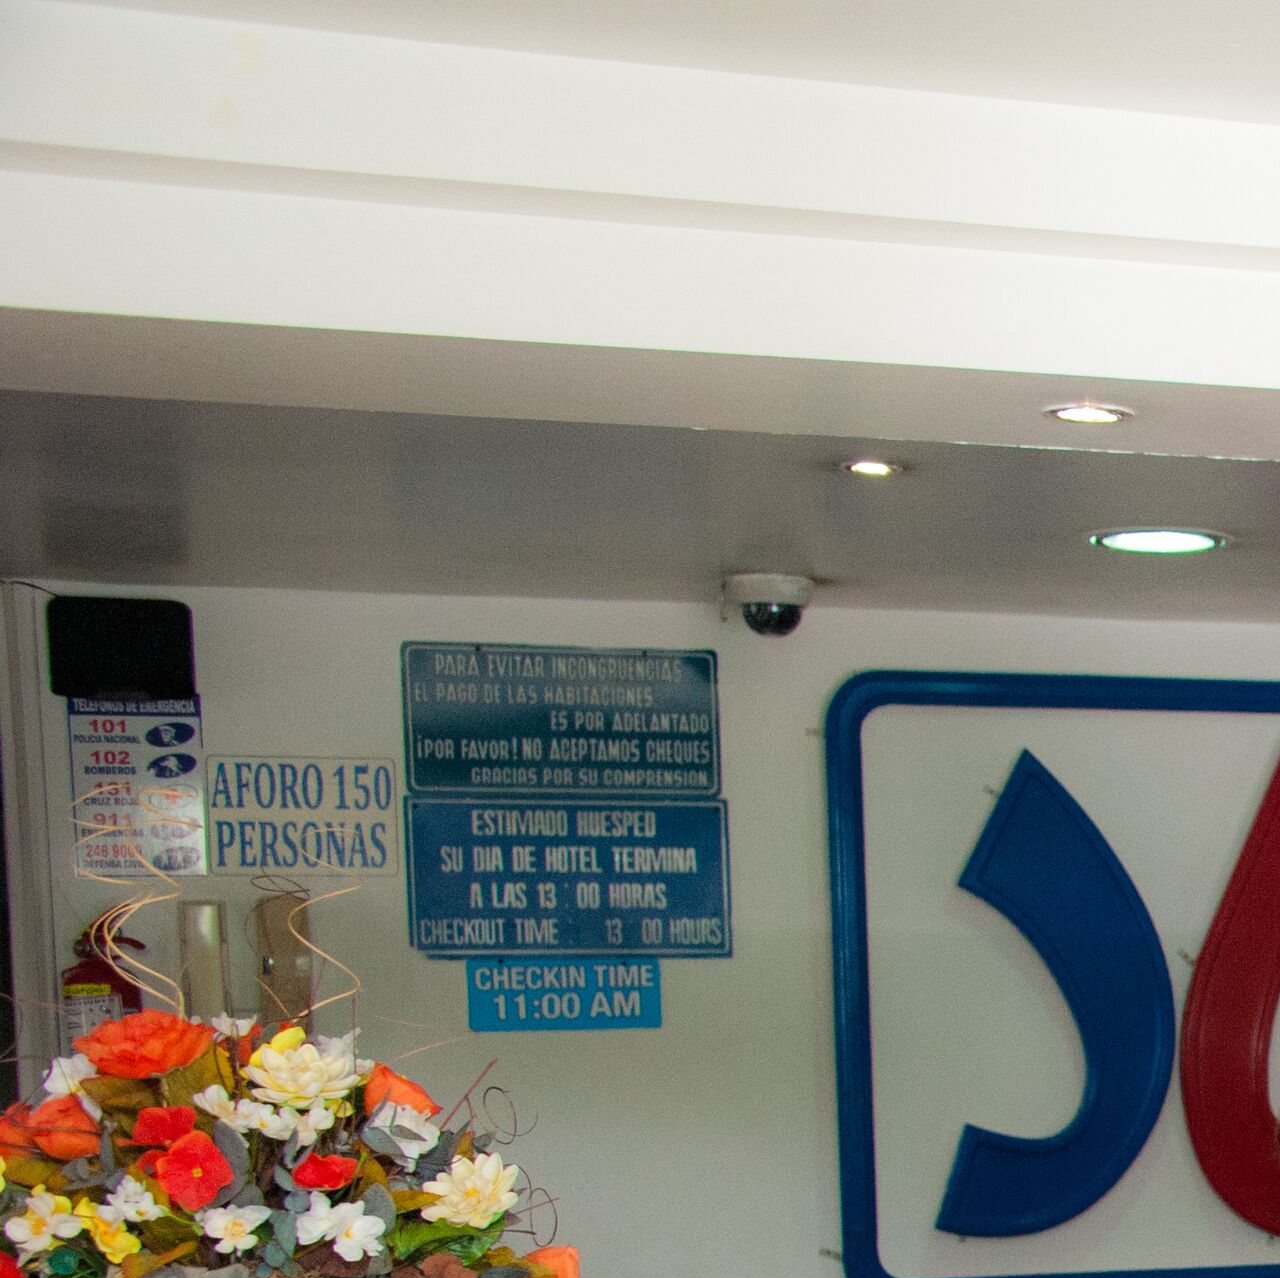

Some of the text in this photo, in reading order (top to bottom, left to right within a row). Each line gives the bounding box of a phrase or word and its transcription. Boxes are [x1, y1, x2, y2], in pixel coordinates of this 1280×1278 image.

[434, 653, 480, 677] PARA
[487, 655, 544, 680] EVITAR
[436, 682, 478, 703] PAGO
[484, 683, 501, 704] DE
[506, 684, 538, 704] LAS
[543, 685, 654, 706] HABITACIONES
[88, 718, 127, 734] 101
[549, 711, 710, 733] ES POR ADELANTADO
[90, 750, 131, 765] 102
[522, 739, 543, 761] NO
[549, 739, 641, 762] ACEPTAMOS
[645, 740, 710, 764] CHEQUES
[84, 766, 137, 776] BOMBEROS
[470, 766, 538, 785] GRACIAS
[543, 767, 573, 785] POR
[578, 767, 598, 785] SU
[210, 761, 392, 811] AFORO 150
[471, 809, 657, 838] ESTIMADO HUESPED
[214, 820, 388, 869] PERSONAS
[440, 846, 698, 874] SU DIA DE HOTEL TERMINA
[470, 882, 483, 909] A
[491, 882, 527, 909] LAS
[609, 882, 668, 909] HORAS
[419, 917, 506, 945] CHECKOUT
[514, 917, 559, 945] TIME
[669, 917, 722, 945] HOURS
[474, 964, 655, 991] CHECKIN TIME
[493, 990, 642, 1020] 11:00 AM
